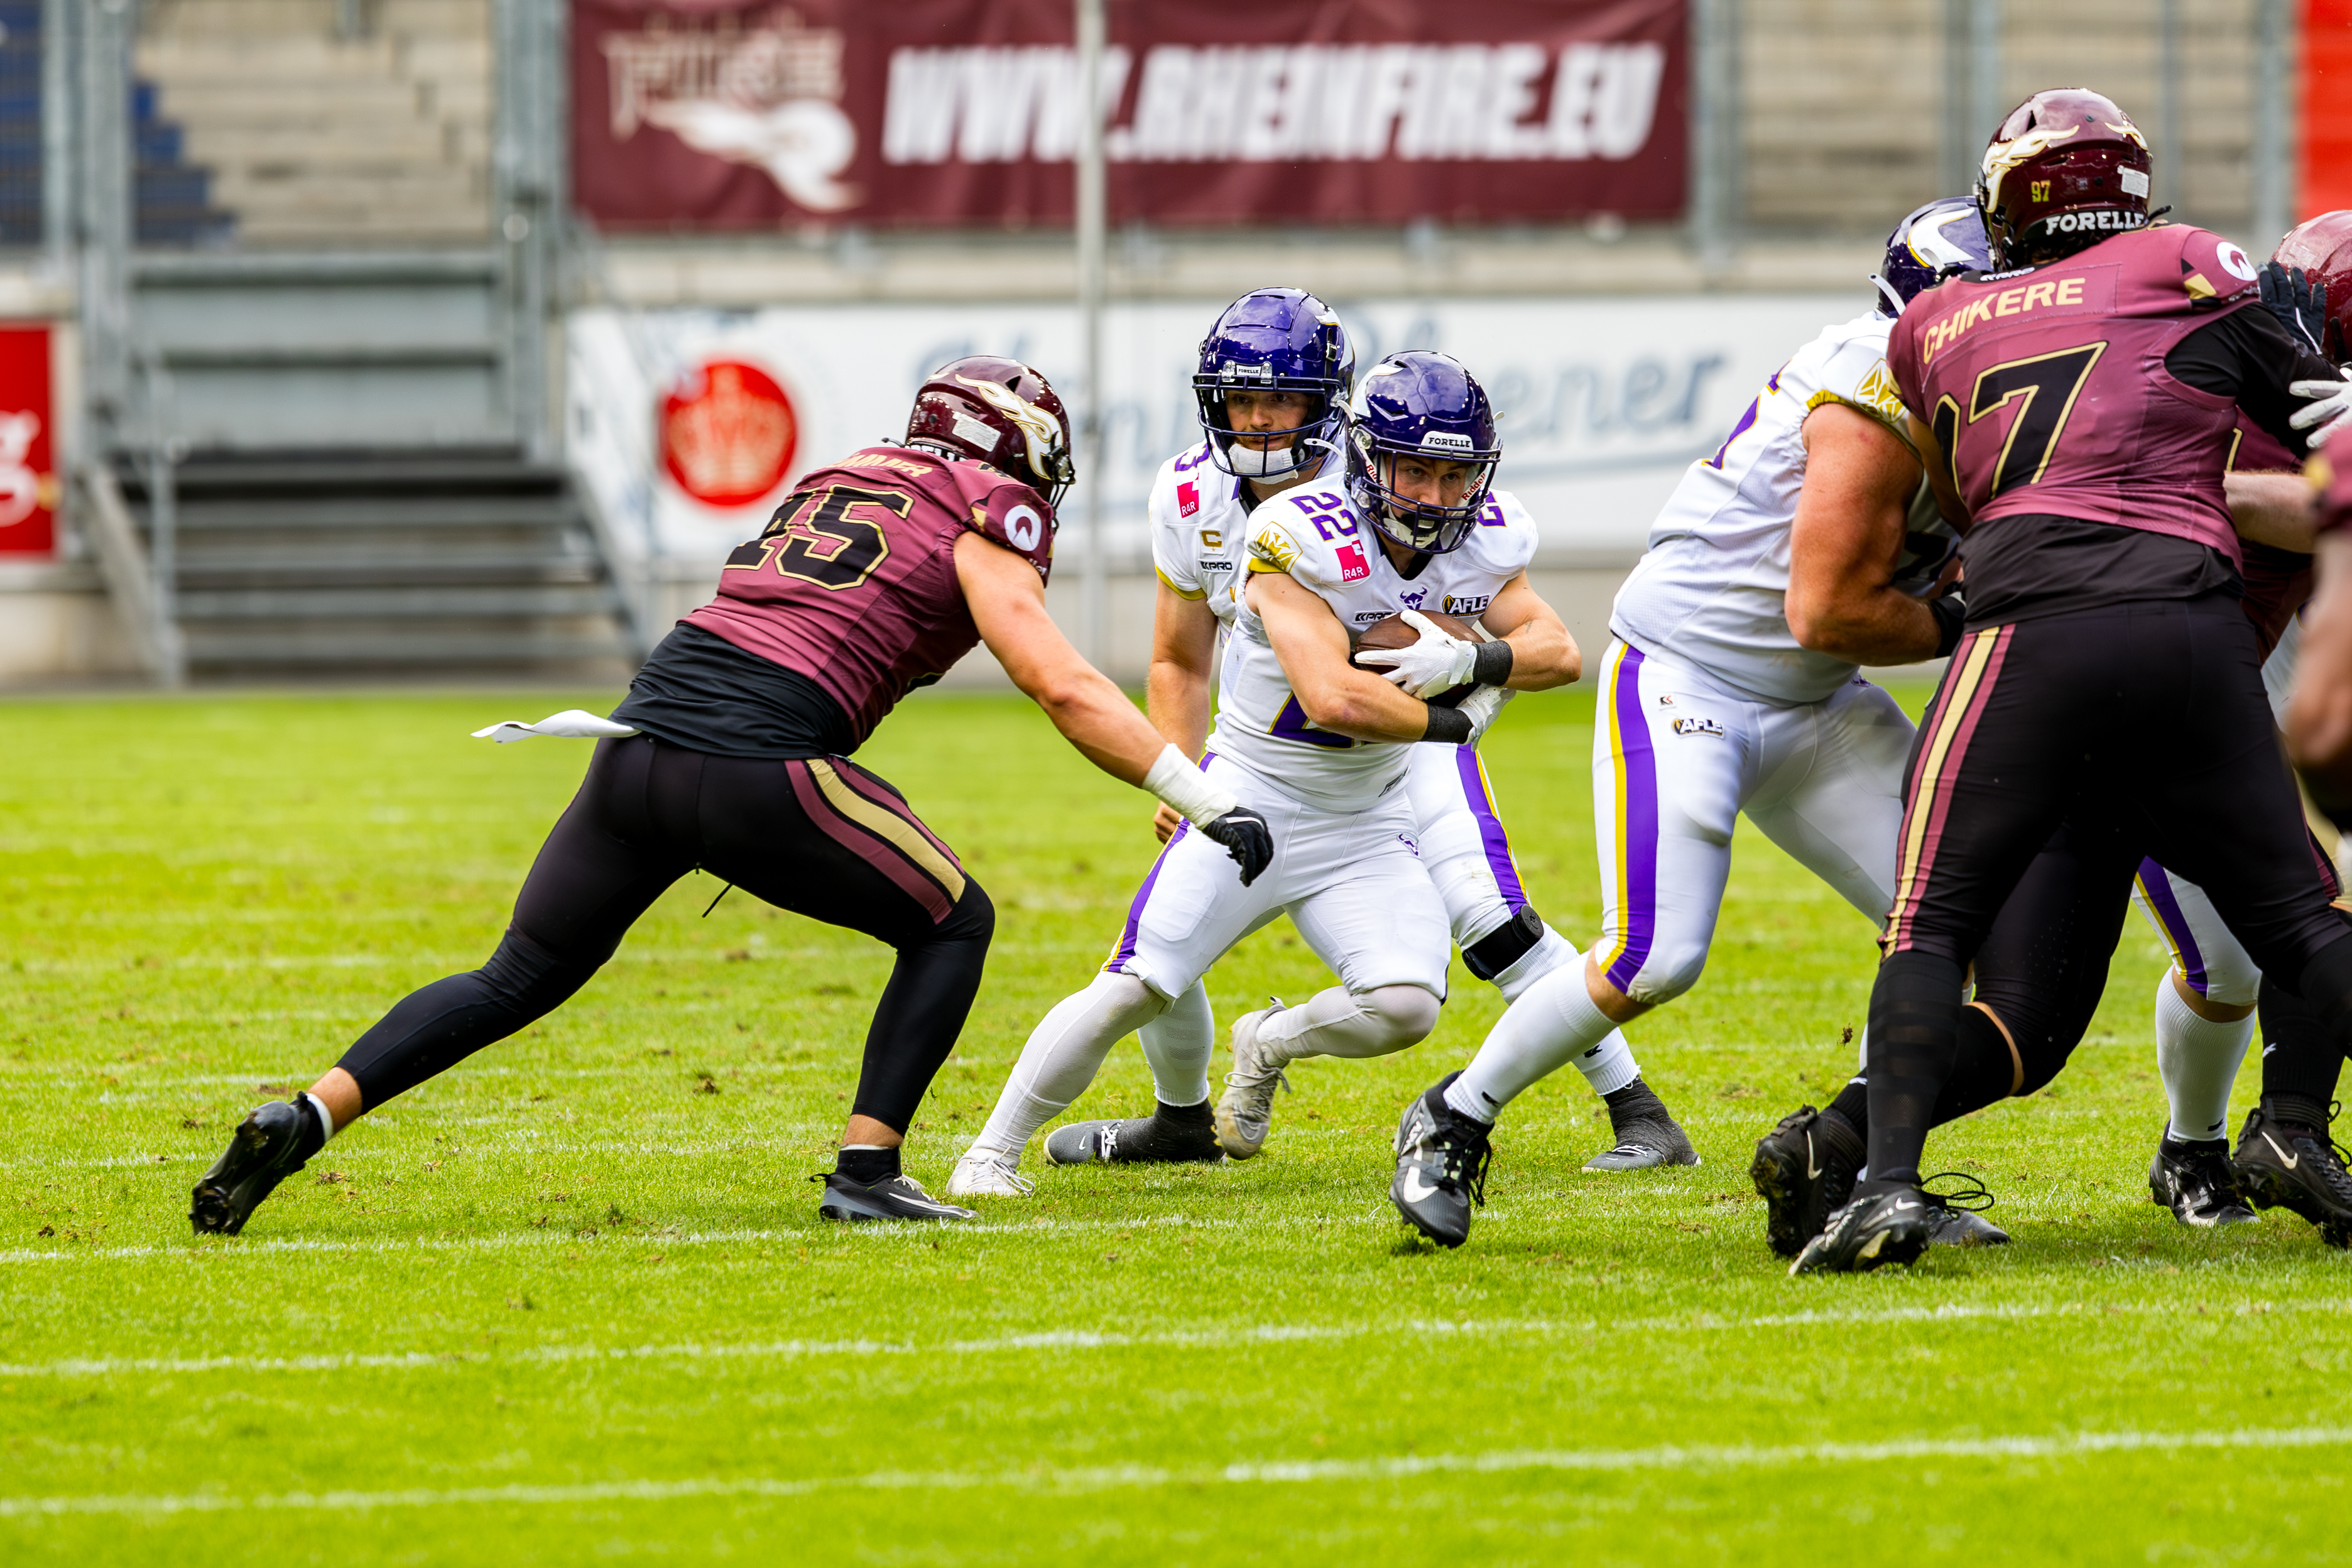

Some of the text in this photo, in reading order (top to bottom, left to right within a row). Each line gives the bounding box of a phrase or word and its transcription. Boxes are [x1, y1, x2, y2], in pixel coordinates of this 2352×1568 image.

[881, 44, 1667, 163] WWW.RHEINFIRE.EU
[2031, 180, 2051, 202] 97
[2046, 211, 2145, 236] FORELLE
[1923, 278, 2086, 364] CHIKERE
[1429, 437, 1471, 448] FORELLE
[1461, 472, 1486, 501] Riddell
[1181, 501, 1197, 516] R4R
[1287, 492, 1359, 542] 22
[724, 483, 914, 591] 45
[1200, 530, 1222, 548] C
[1344, 566, 1364, 580] R4R
[1449, 596, 1488, 614] AFLE
[1680, 719, 1723, 734] AFLE
